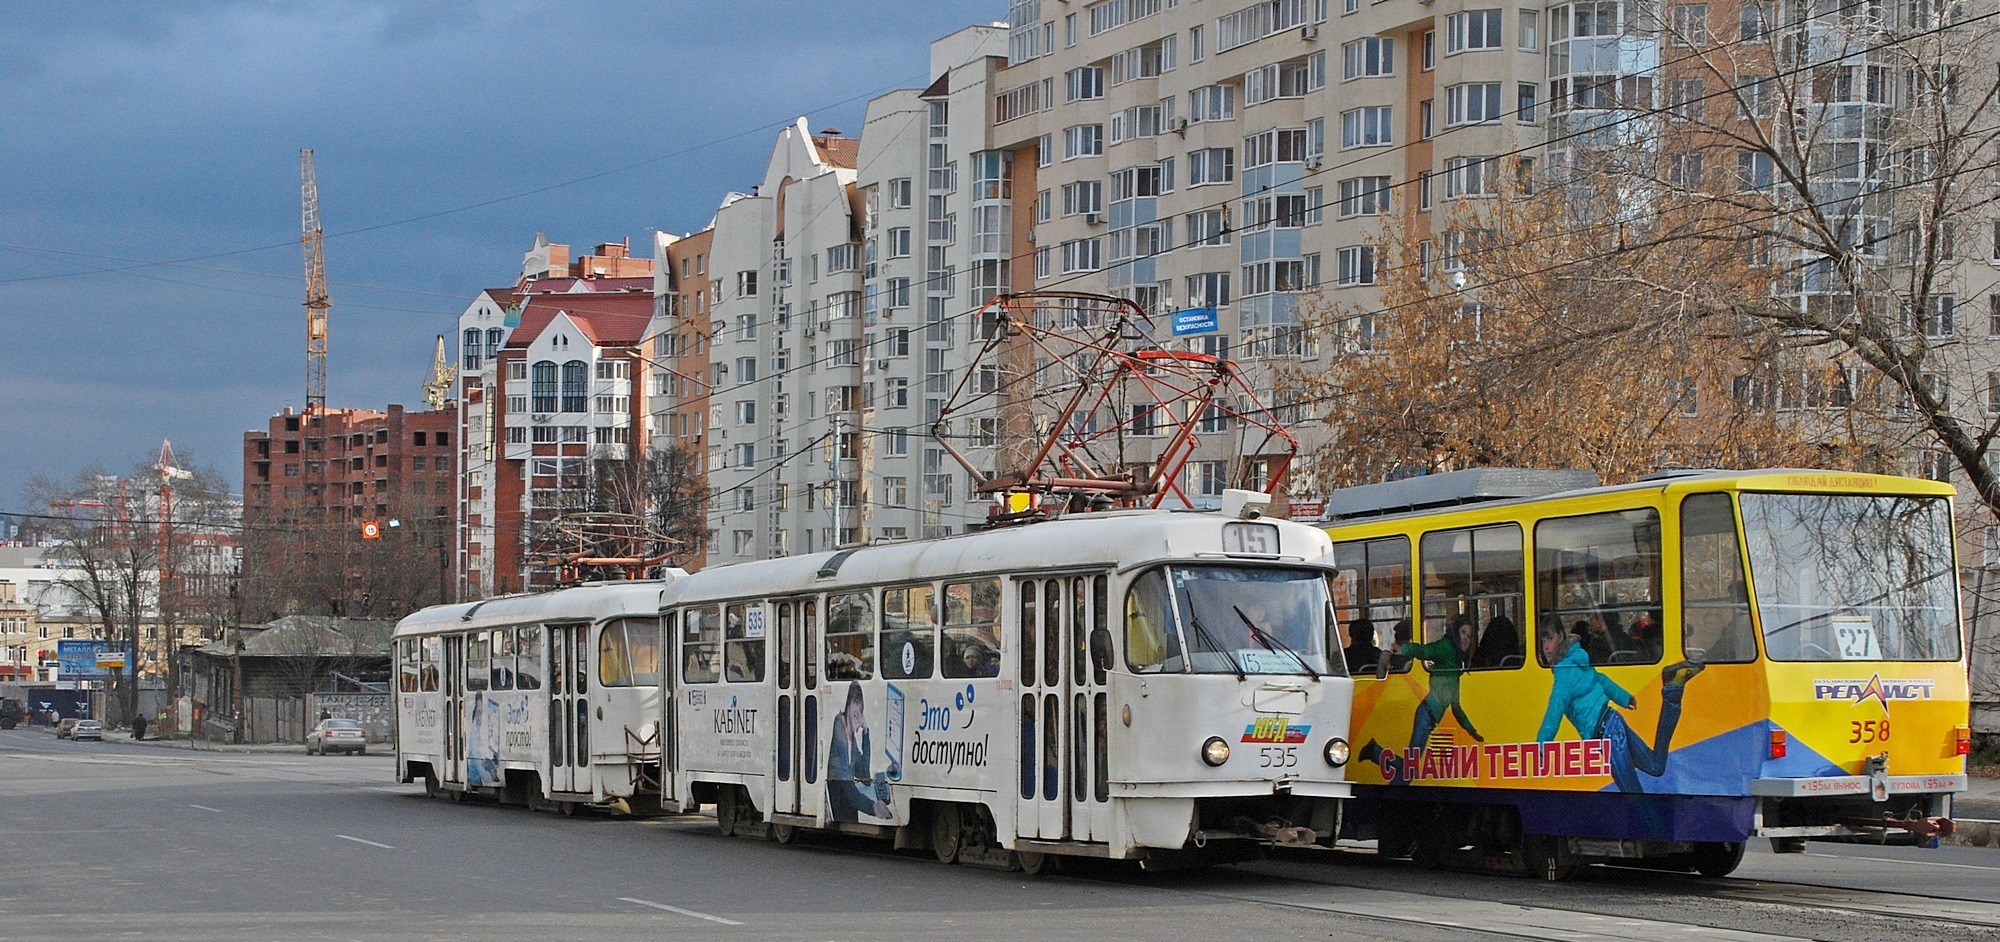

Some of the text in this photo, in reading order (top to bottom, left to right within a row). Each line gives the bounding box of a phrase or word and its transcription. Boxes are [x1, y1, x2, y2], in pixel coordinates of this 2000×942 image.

[1176, 321, 1213, 331] БЕЗОПАСНОСТИ
[1179, 315, 1208, 323] ОСТАНОВКА
[1233, 527, 1267, 554] 15
[748, 611, 763, 630] 535
[1839, 628, 1870, 657] 27
[1241, 652, 1261, 673] 15
[919, 699, 950, 731] Это
[1252, 717, 1290, 742] ЮТД
[1849, 720, 1890, 743] 358
[912, 730, 989, 774] доступно!
[1260, 747, 1298, 768] 535
[1379, 739, 1611, 780] С НАМИ ТЕПЛЕЕ!
[1833, 782, 1861, 790] ВЫНОС
[1890, 781, 1920, 789] КУЗОВА
